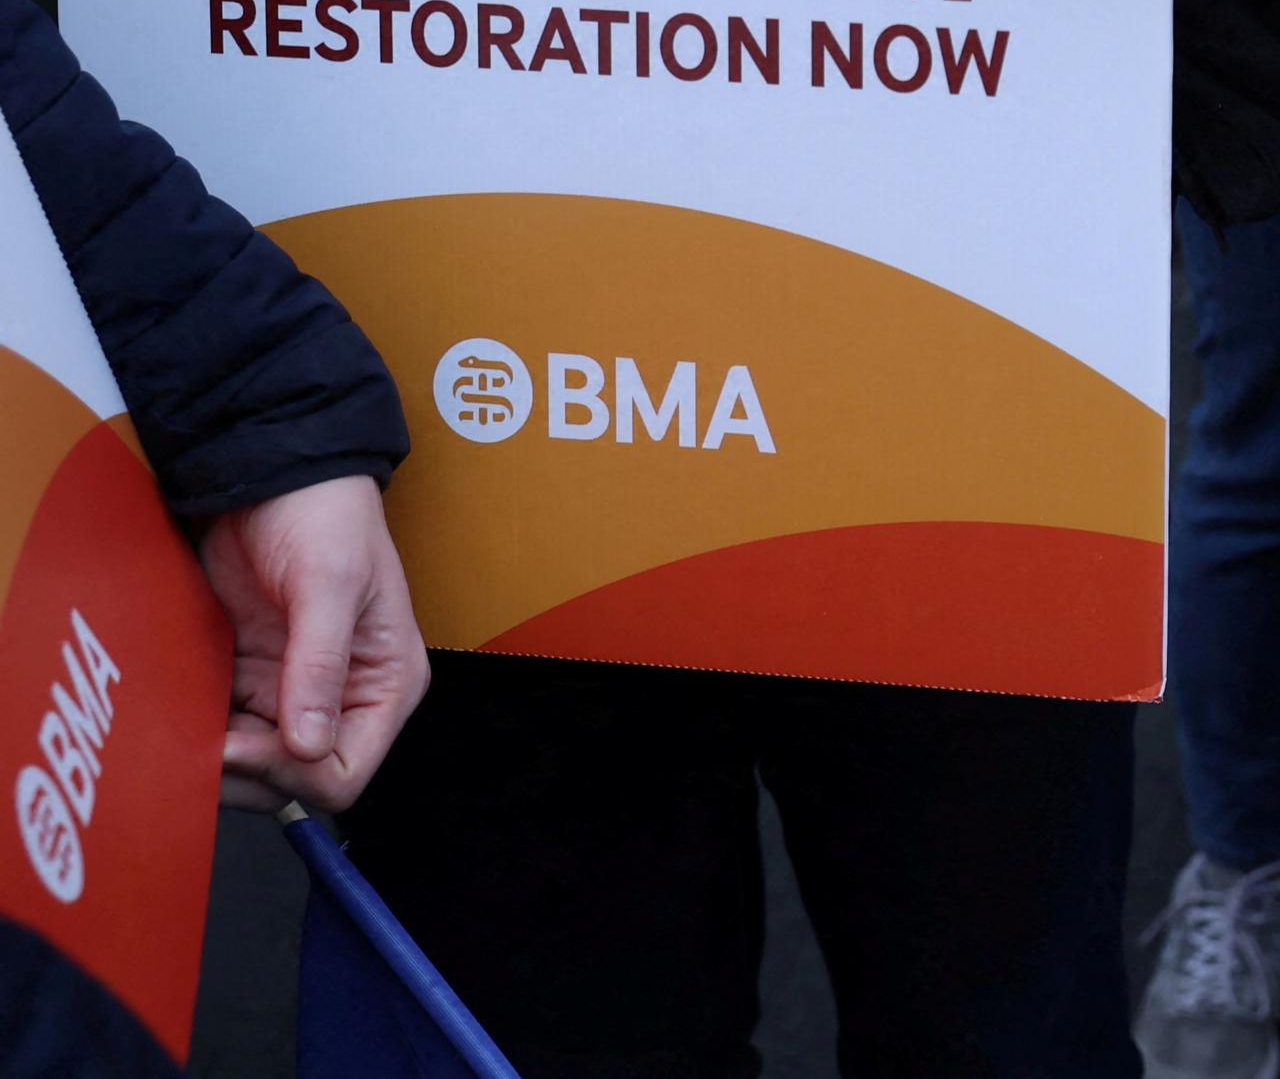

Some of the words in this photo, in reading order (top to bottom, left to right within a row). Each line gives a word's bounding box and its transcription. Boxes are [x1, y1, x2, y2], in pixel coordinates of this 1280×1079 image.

[810, 20, 1011, 97] NOW
[547, 353, 777, 454] BMA
[37, 607, 121, 828] BMA
